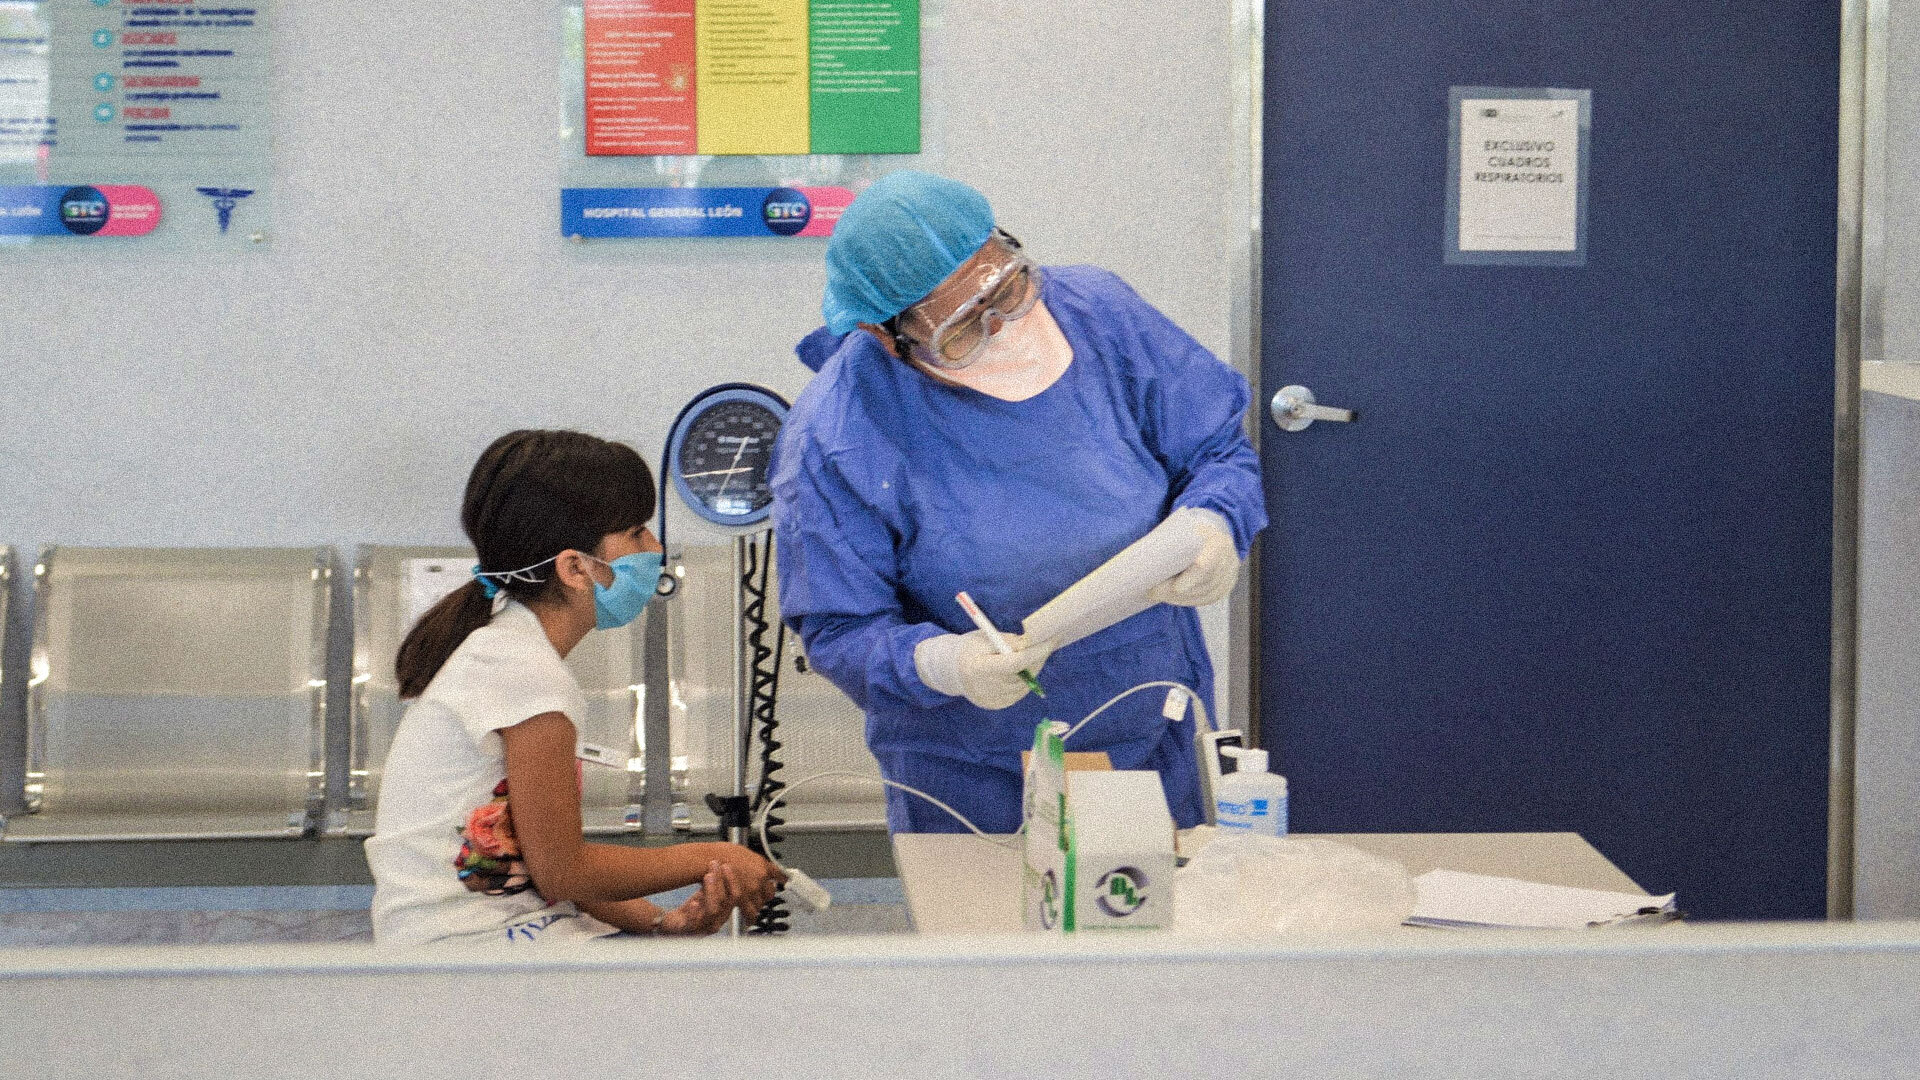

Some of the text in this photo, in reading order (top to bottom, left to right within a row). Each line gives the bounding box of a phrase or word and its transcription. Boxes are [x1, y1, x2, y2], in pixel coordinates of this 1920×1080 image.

[1484, 140, 1556, 152] EXCLUSIVO
[1488, 156, 1552, 168] CUADROS
[1474, 172, 1564, 184] RESPIRATORIOS
[583, 203, 743, 219] HOSPITAL GENERAL LEÓN
[766, 202, 807, 218] GTO
